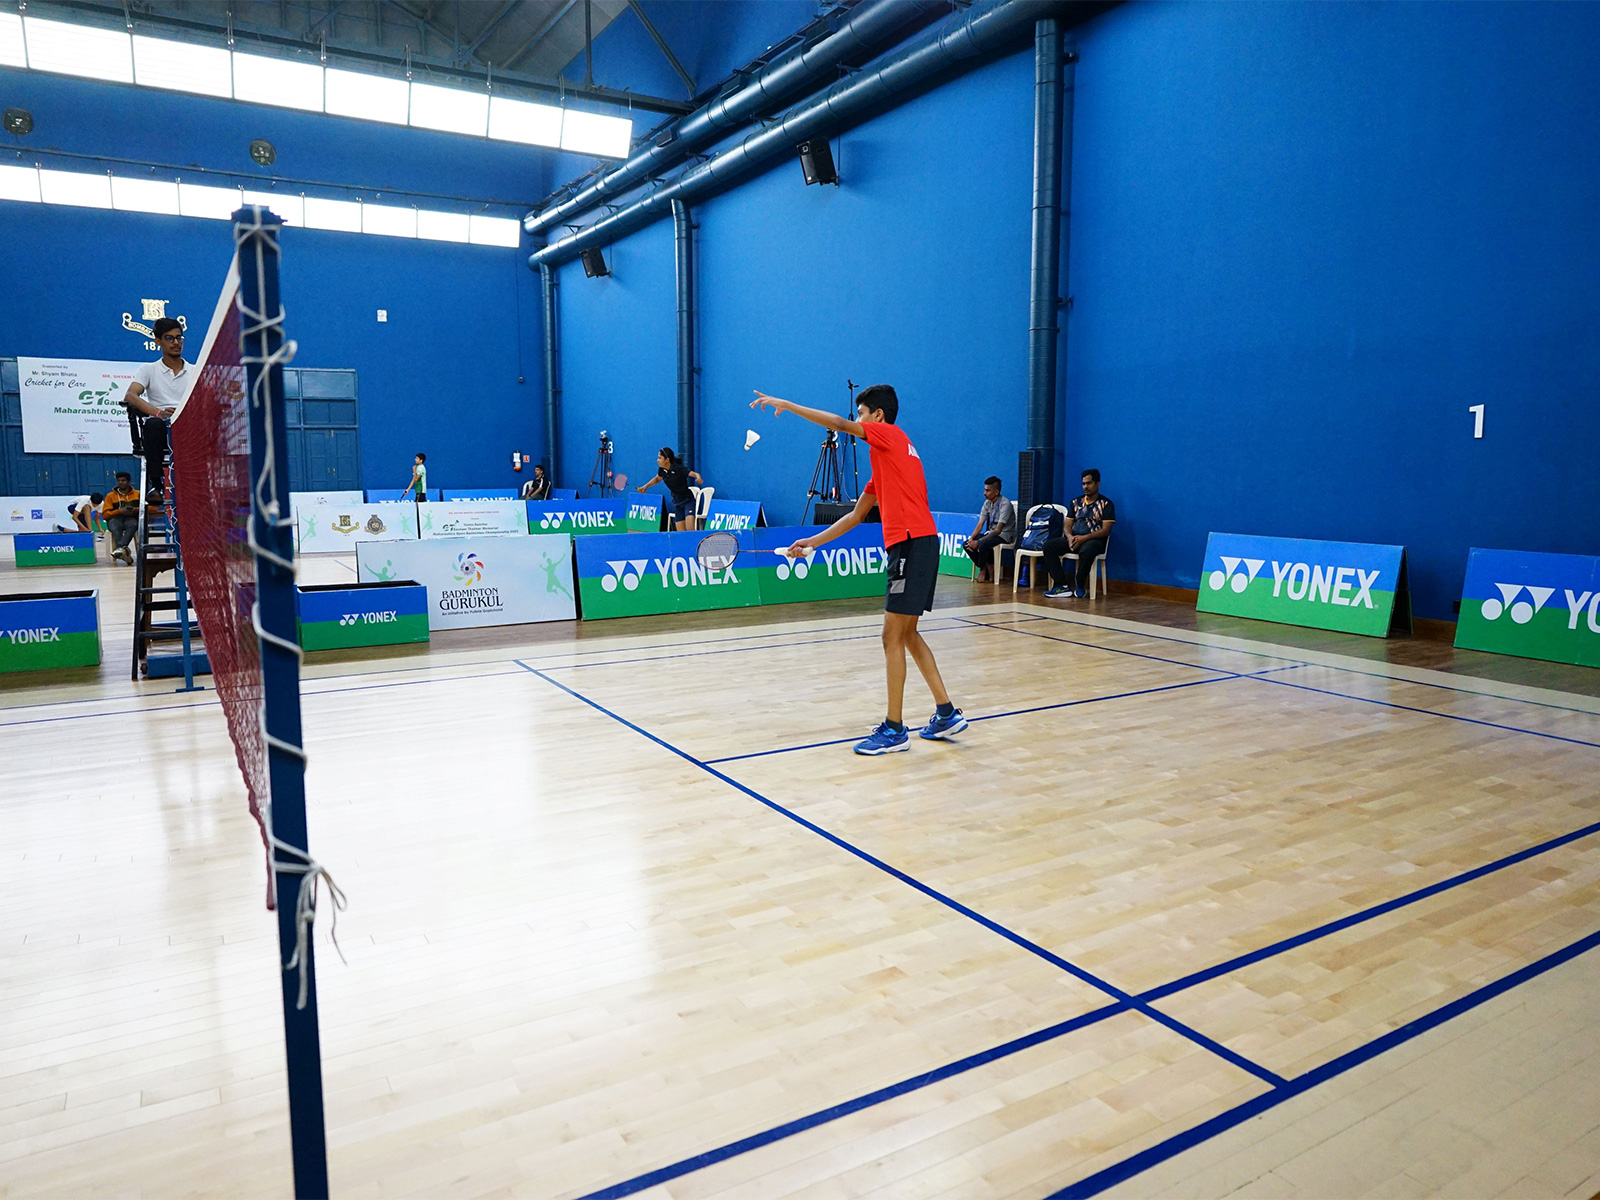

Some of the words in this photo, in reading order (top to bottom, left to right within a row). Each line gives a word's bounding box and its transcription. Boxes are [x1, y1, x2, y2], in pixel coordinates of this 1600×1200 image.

[25, 377, 52, 387] Cricket
[54, 380, 65, 388] for
[68, 379, 87, 389] Care
[53, 407, 109, 415] Maharashtra
[110, 407, 127, 416] Ope
[1469, 404, 1485, 438] 1
[568, 511, 615, 528] YONEX
[639, 504, 657, 521] YONEX
[51, 545, 75, 553] YONEX
[937, 532, 971, 558] ONEX
[821, 547, 889, 577] YONEX
[654, 556, 739, 588] YONEX
[442, 587, 499, 599] BADMINTON
[1271, 561, 1380, 609] YONEX
[439, 596, 504, 611] GURUKUL
[361, 610, 398, 624] YONEX
[7, 627, 60, 645] YONEX
